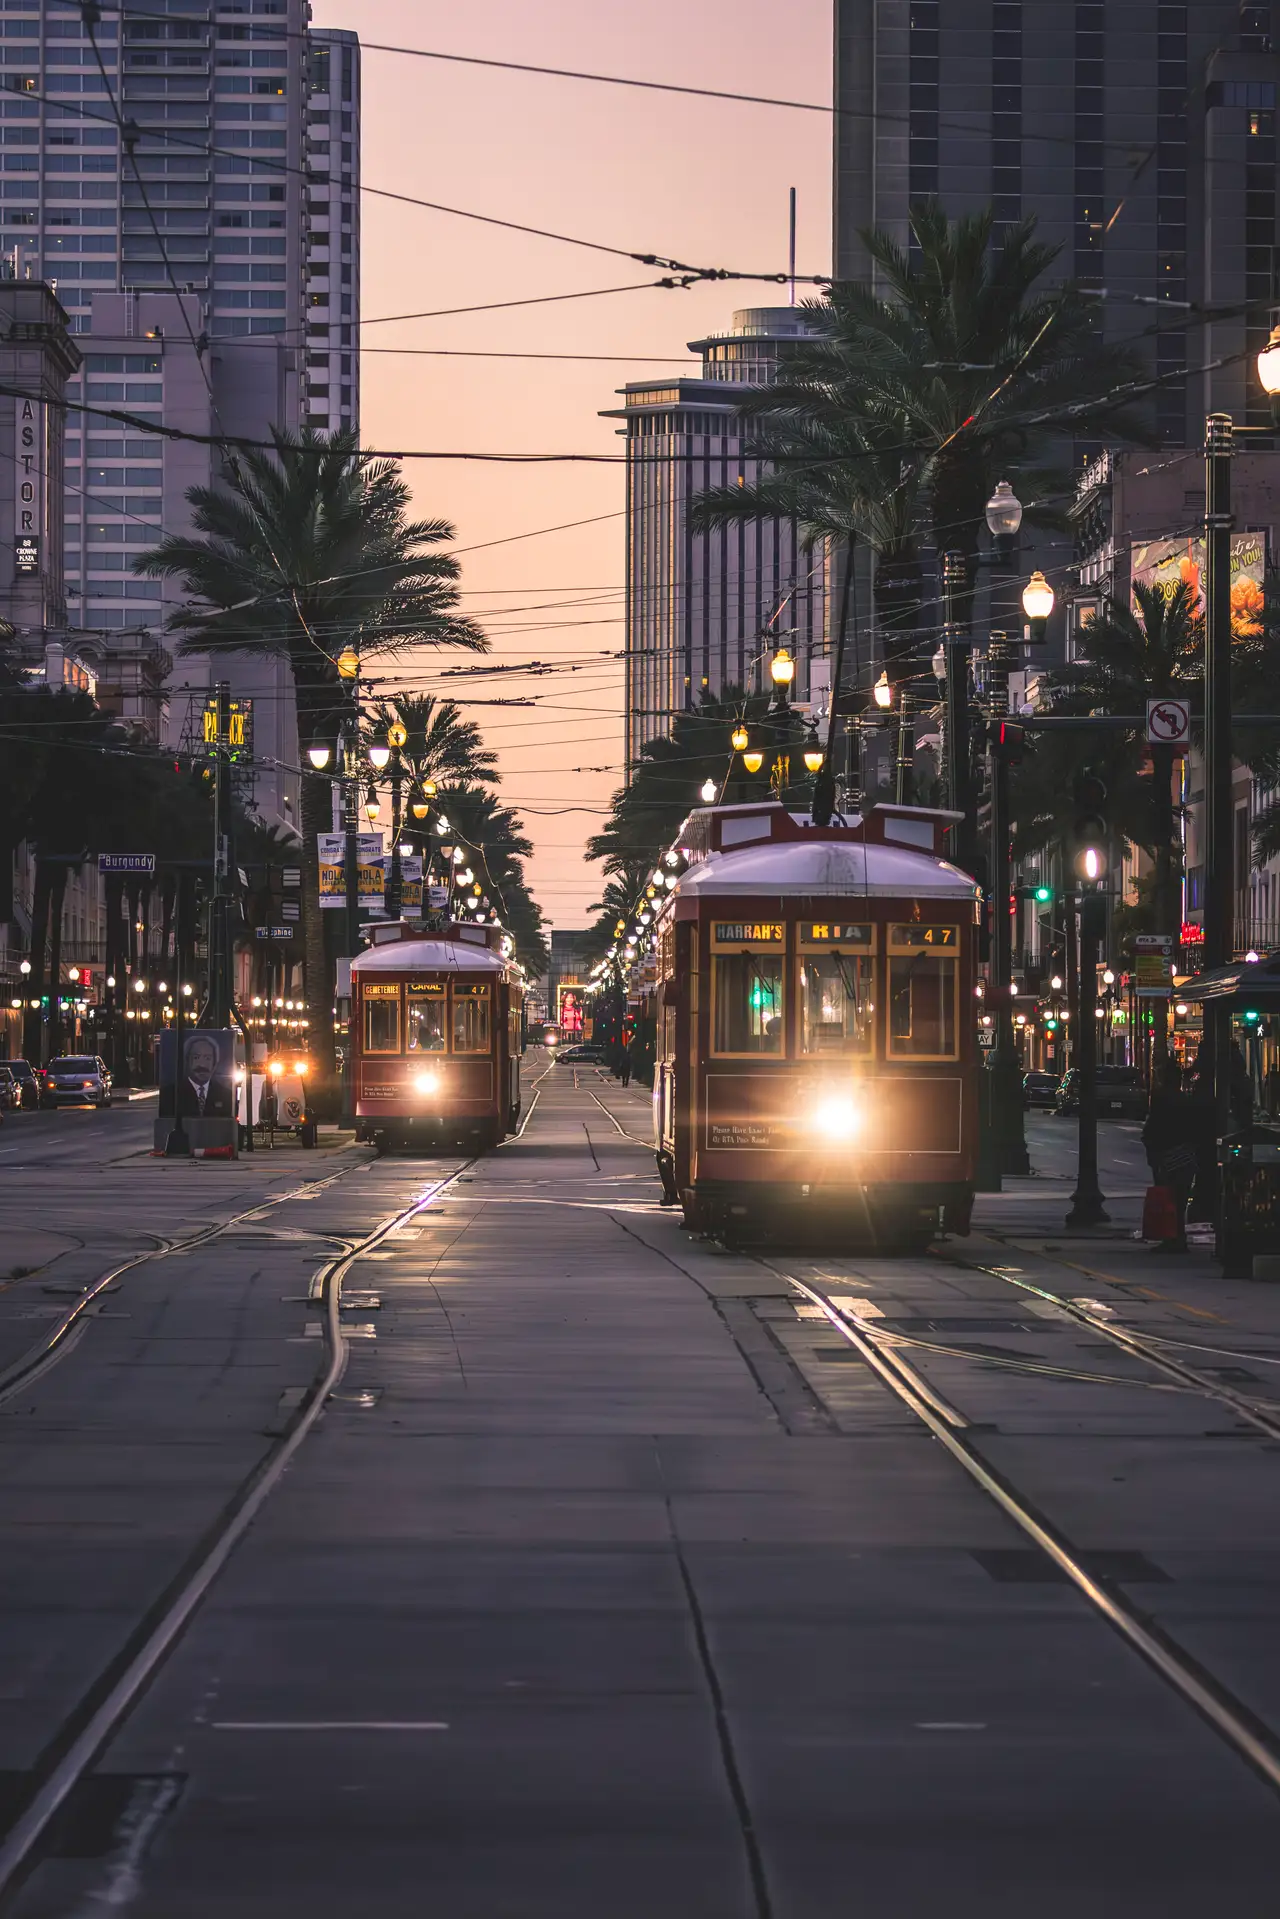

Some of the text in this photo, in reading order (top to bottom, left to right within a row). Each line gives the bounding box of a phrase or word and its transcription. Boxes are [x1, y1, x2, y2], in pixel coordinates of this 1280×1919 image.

[21, 400, 34, 530] ASTOR
[204, 712, 244, 744] PACE
[105, 855, 153, 870] Burgundy
[717, 925, 783, 940] HARRAH'S
[365, 985, 399, 994] CEMETERIES
[979, 1035, 990, 1044] AY
